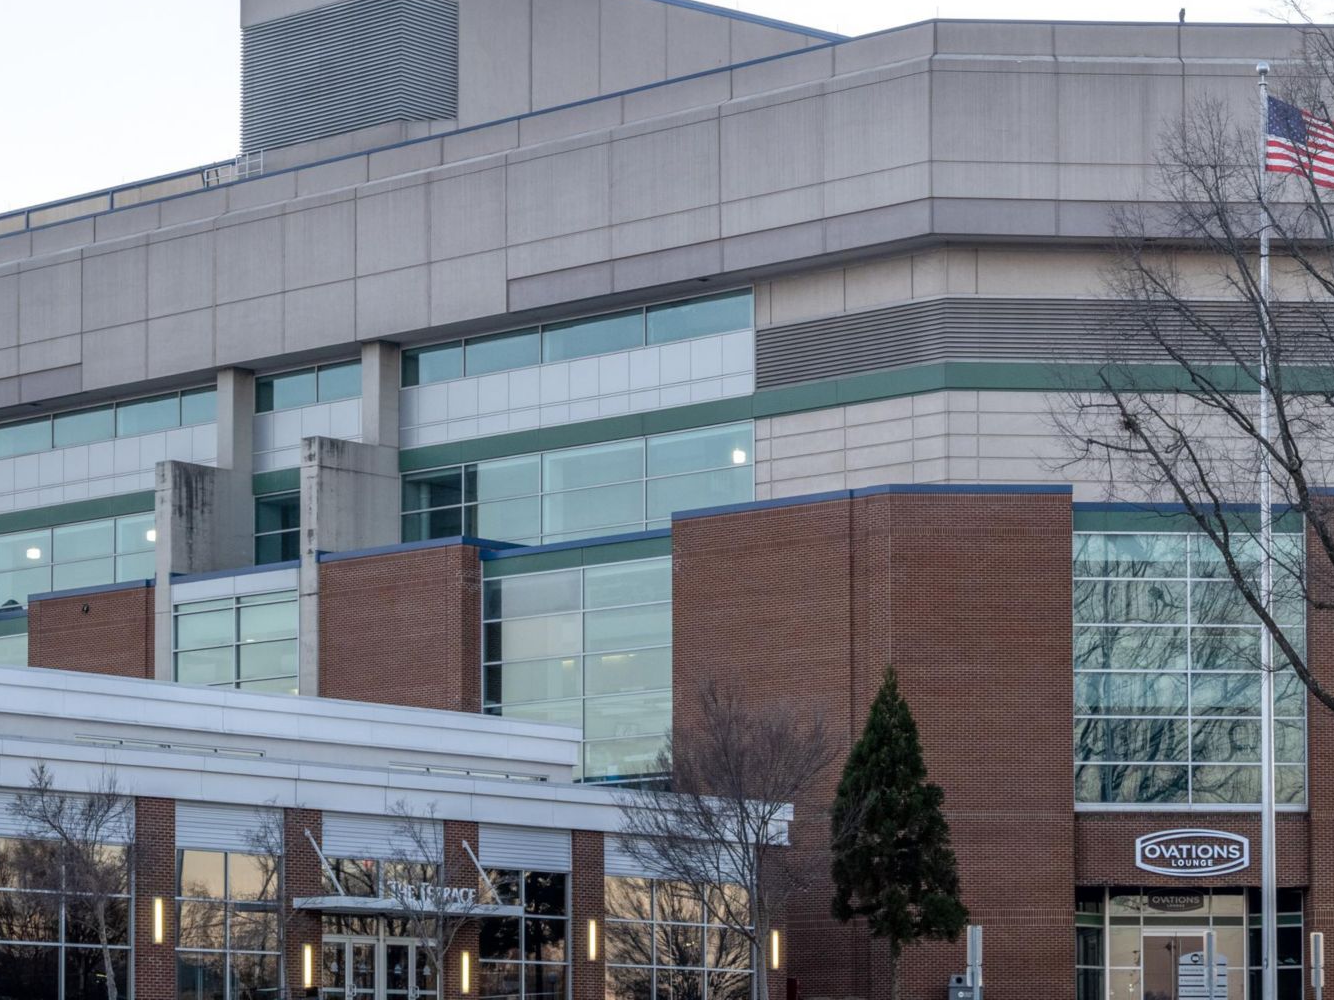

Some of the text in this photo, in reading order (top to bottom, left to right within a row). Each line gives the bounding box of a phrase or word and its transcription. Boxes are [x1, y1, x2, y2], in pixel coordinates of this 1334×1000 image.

[1144, 844, 1241, 859] OVATIONS
[1171, 859, 1214, 867] LOUNGE
[1151, 895, 1200, 904] OVATIONS
